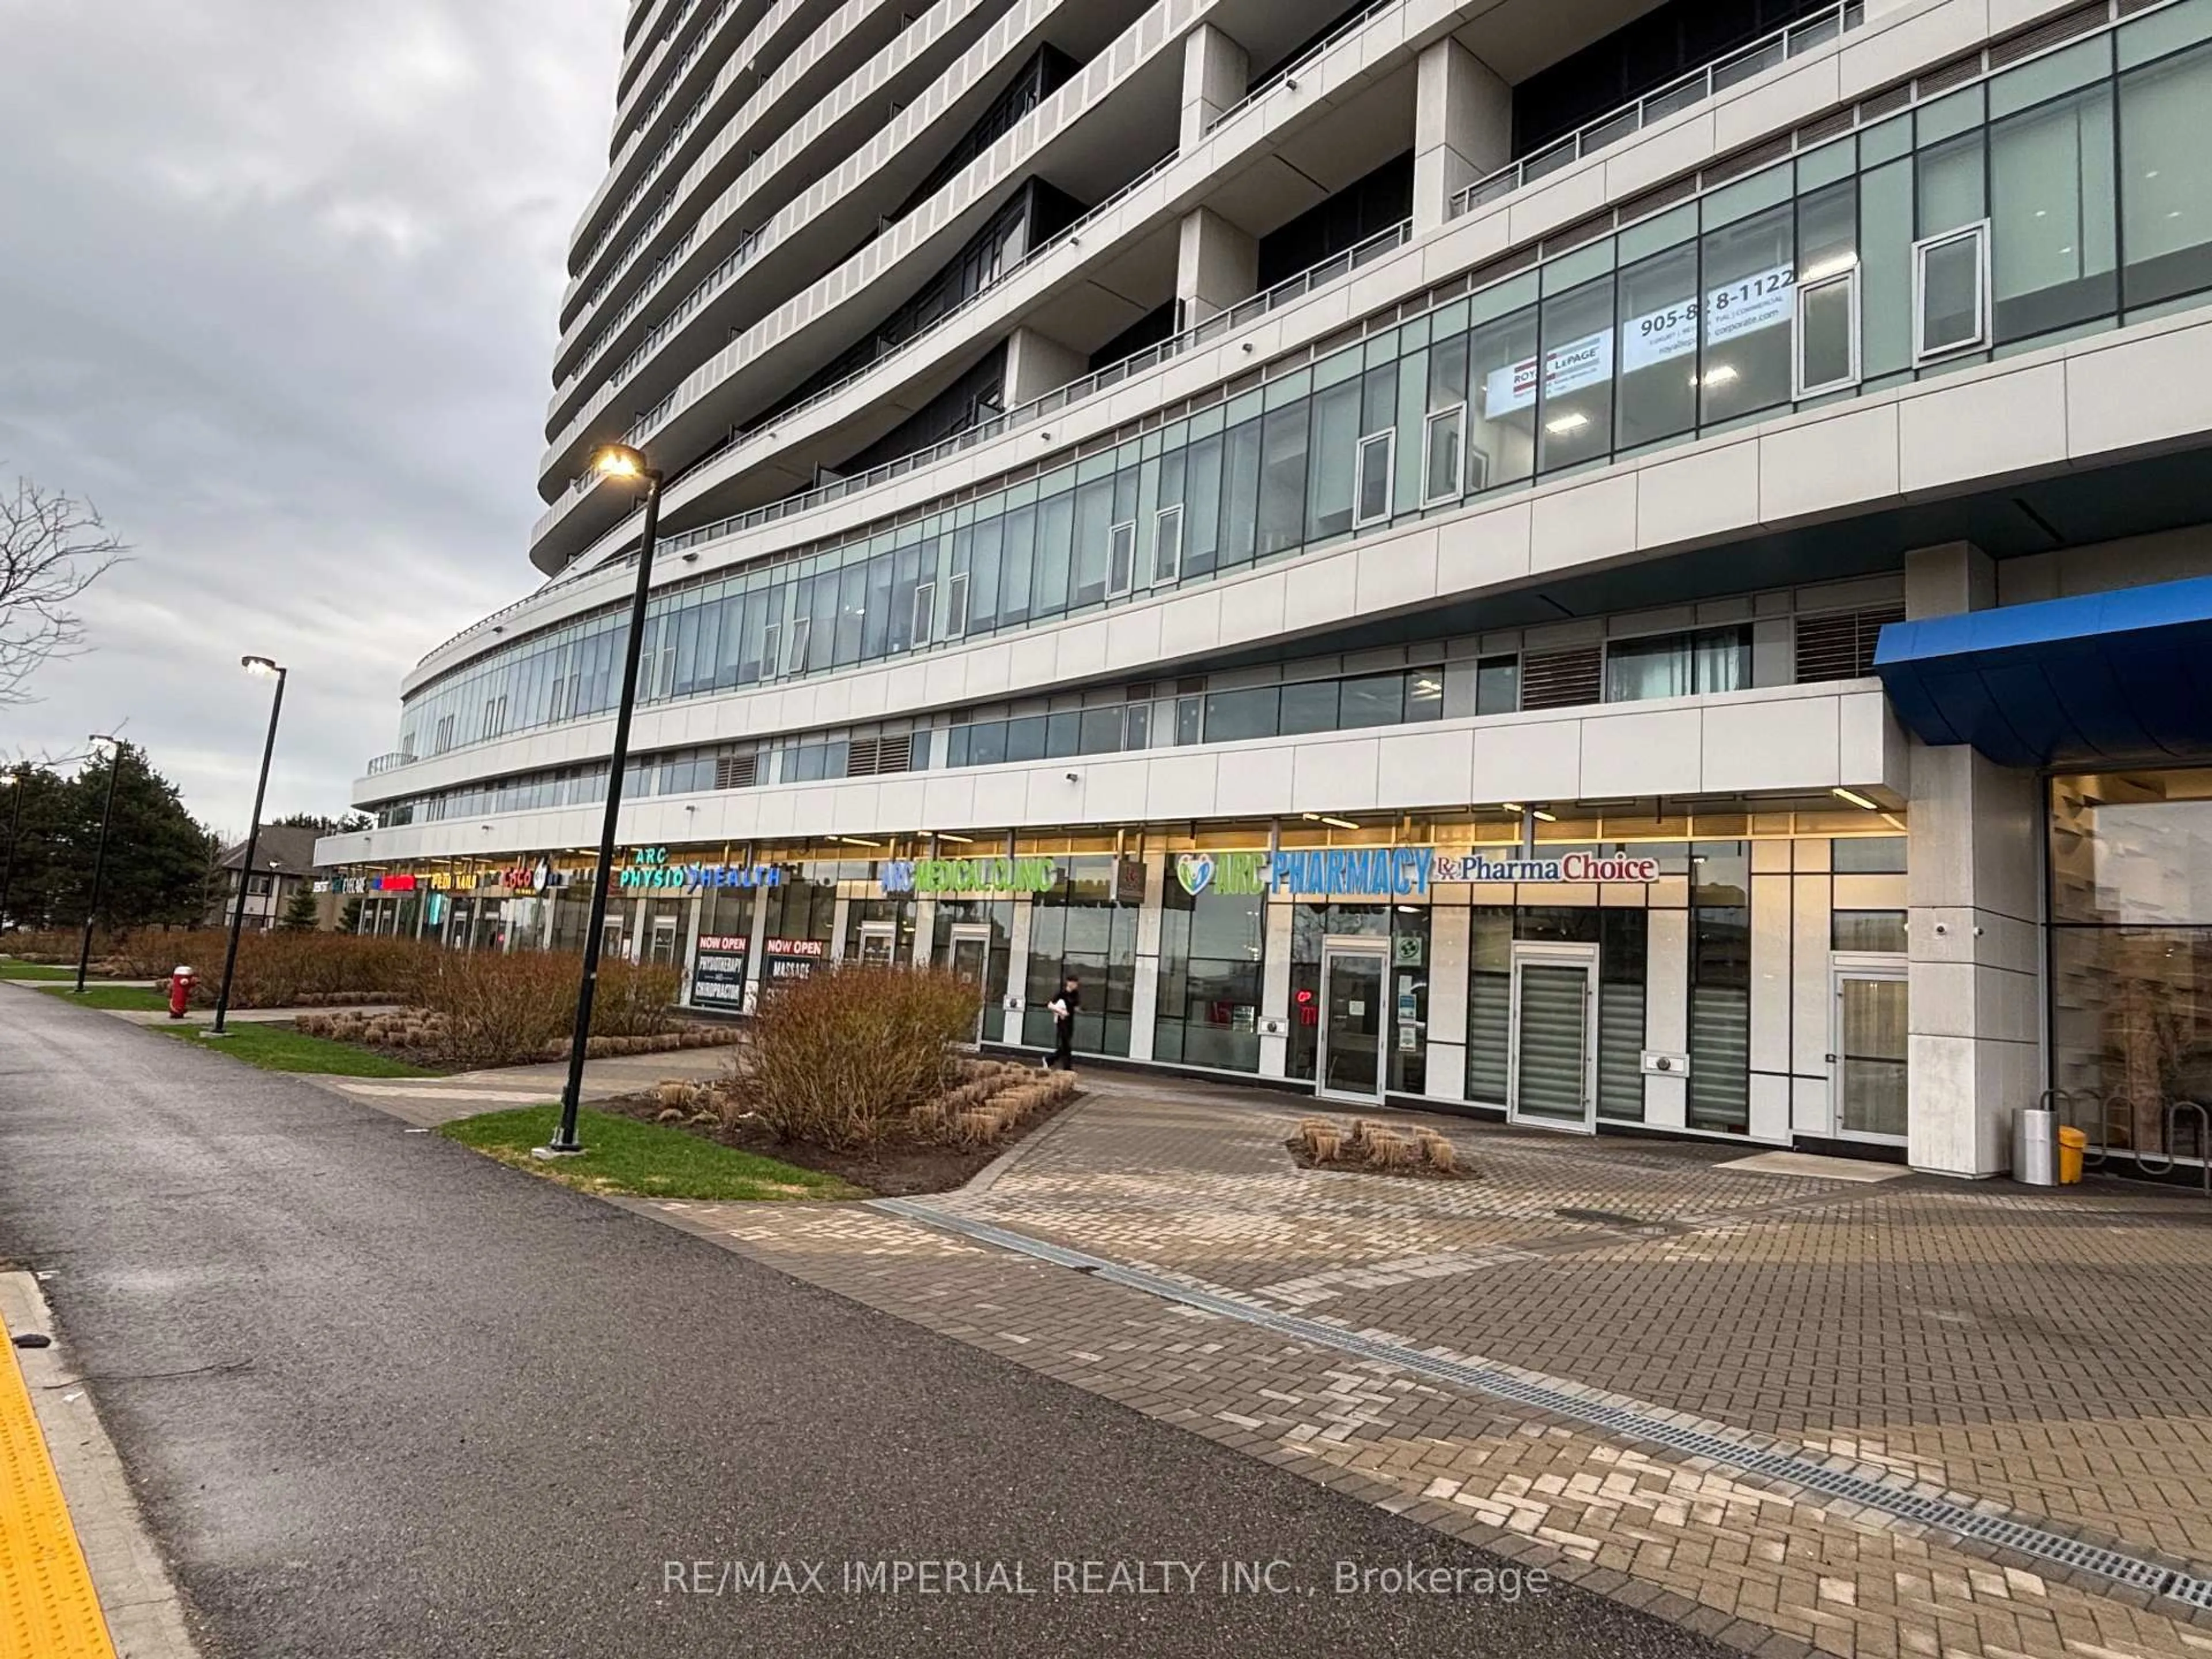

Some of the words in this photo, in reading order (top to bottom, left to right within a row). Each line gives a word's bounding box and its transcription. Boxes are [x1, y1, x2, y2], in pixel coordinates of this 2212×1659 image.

[636, 847, 666, 864] ARC
[620, 868, 684, 887] PHYSIO
[1213, 853, 1266, 895] ARC
[1271, 847, 1433, 895] PHARMACY
[700, 937, 721, 949] NOW
[722, 938, 746, 950] OPEN
[767, 940, 792, 952] NOW
[793, 941, 822, 955] OPEN
